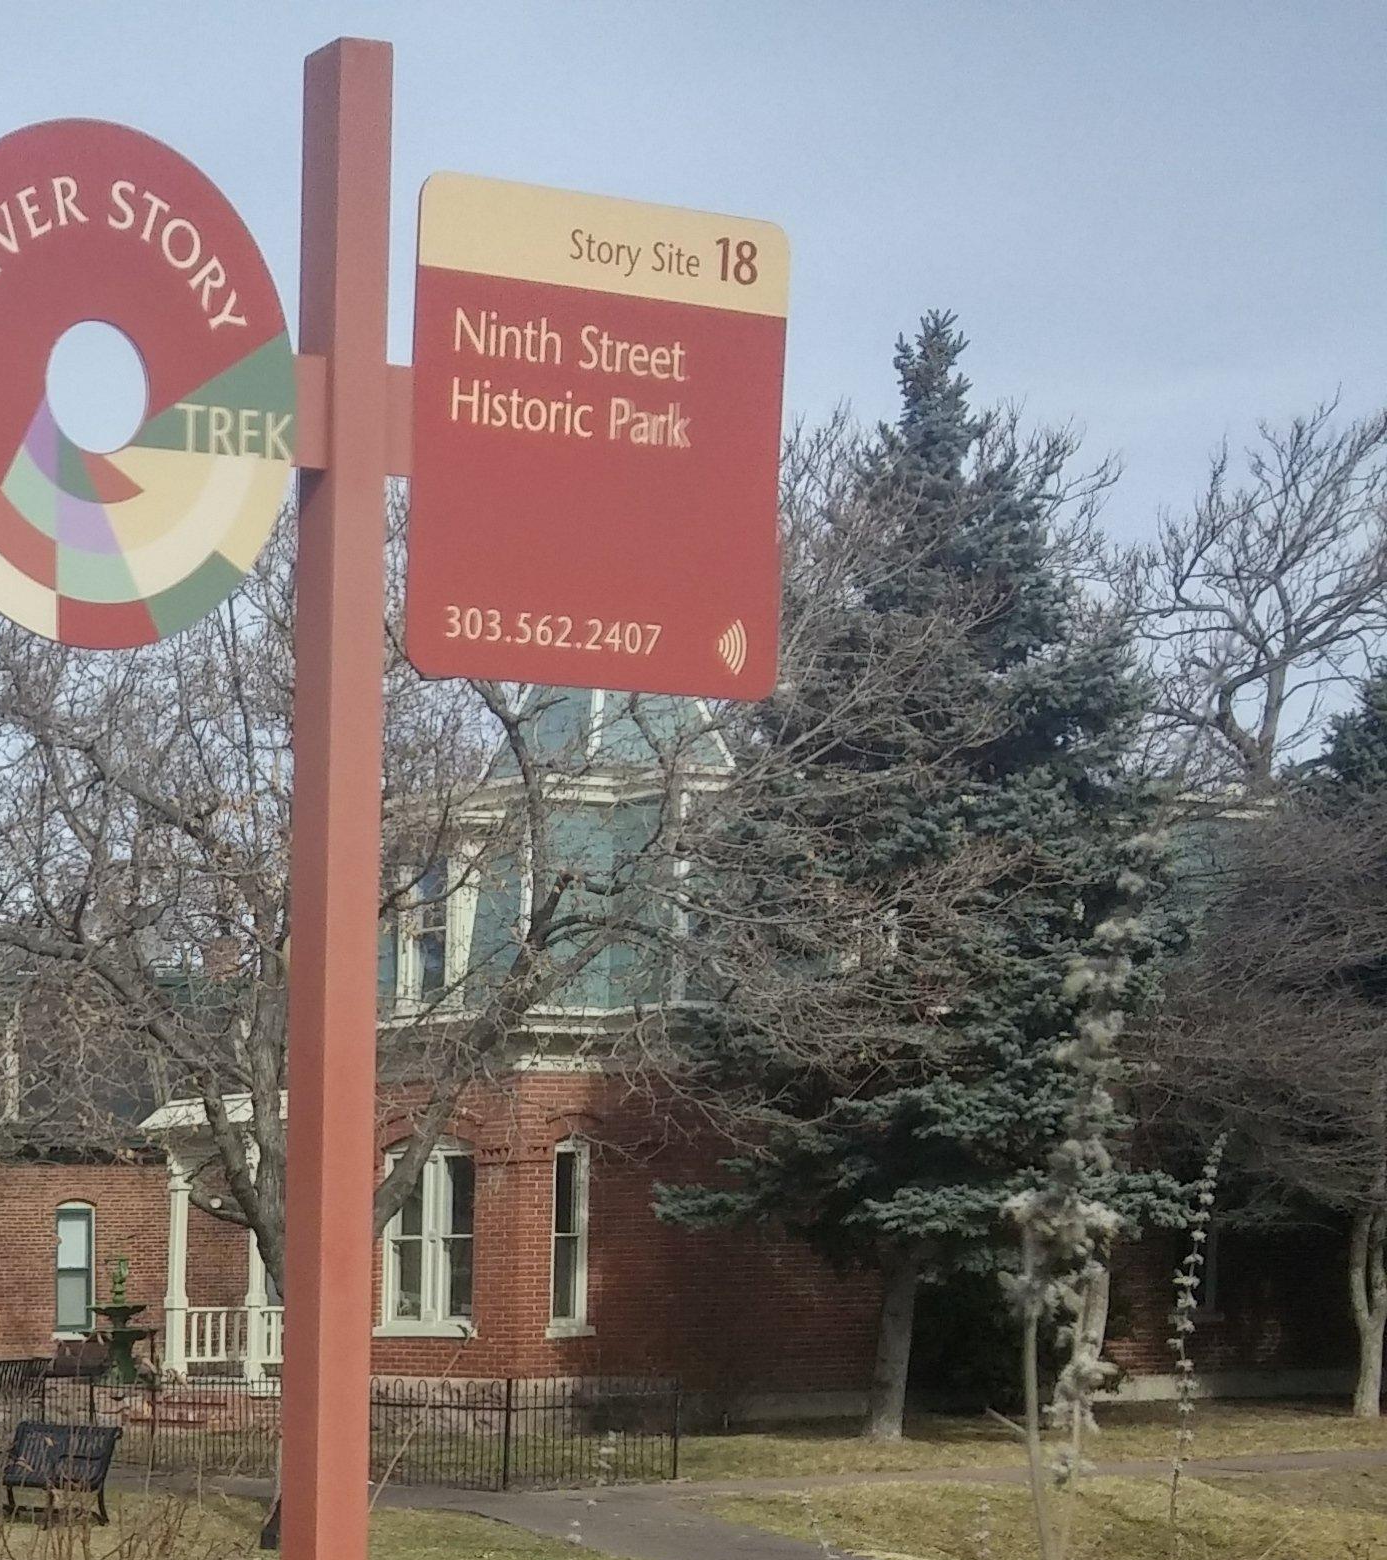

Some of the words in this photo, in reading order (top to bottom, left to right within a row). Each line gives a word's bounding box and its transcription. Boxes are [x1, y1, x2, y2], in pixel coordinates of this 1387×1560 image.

[108, 179, 248, 333] STORY
[569, 228, 641, 276] Story
[652, 239, 702, 279] Site
[714, 236, 760, 287] 18
[454, 308, 563, 366] Ninth
[578, 324, 688, 383] Street
[173, 401, 294, 463] TREK
[449, 380, 594, 440] Historic
[609, 397, 693, 449] Park
[444, 604, 664, 657] 303.562.2407
